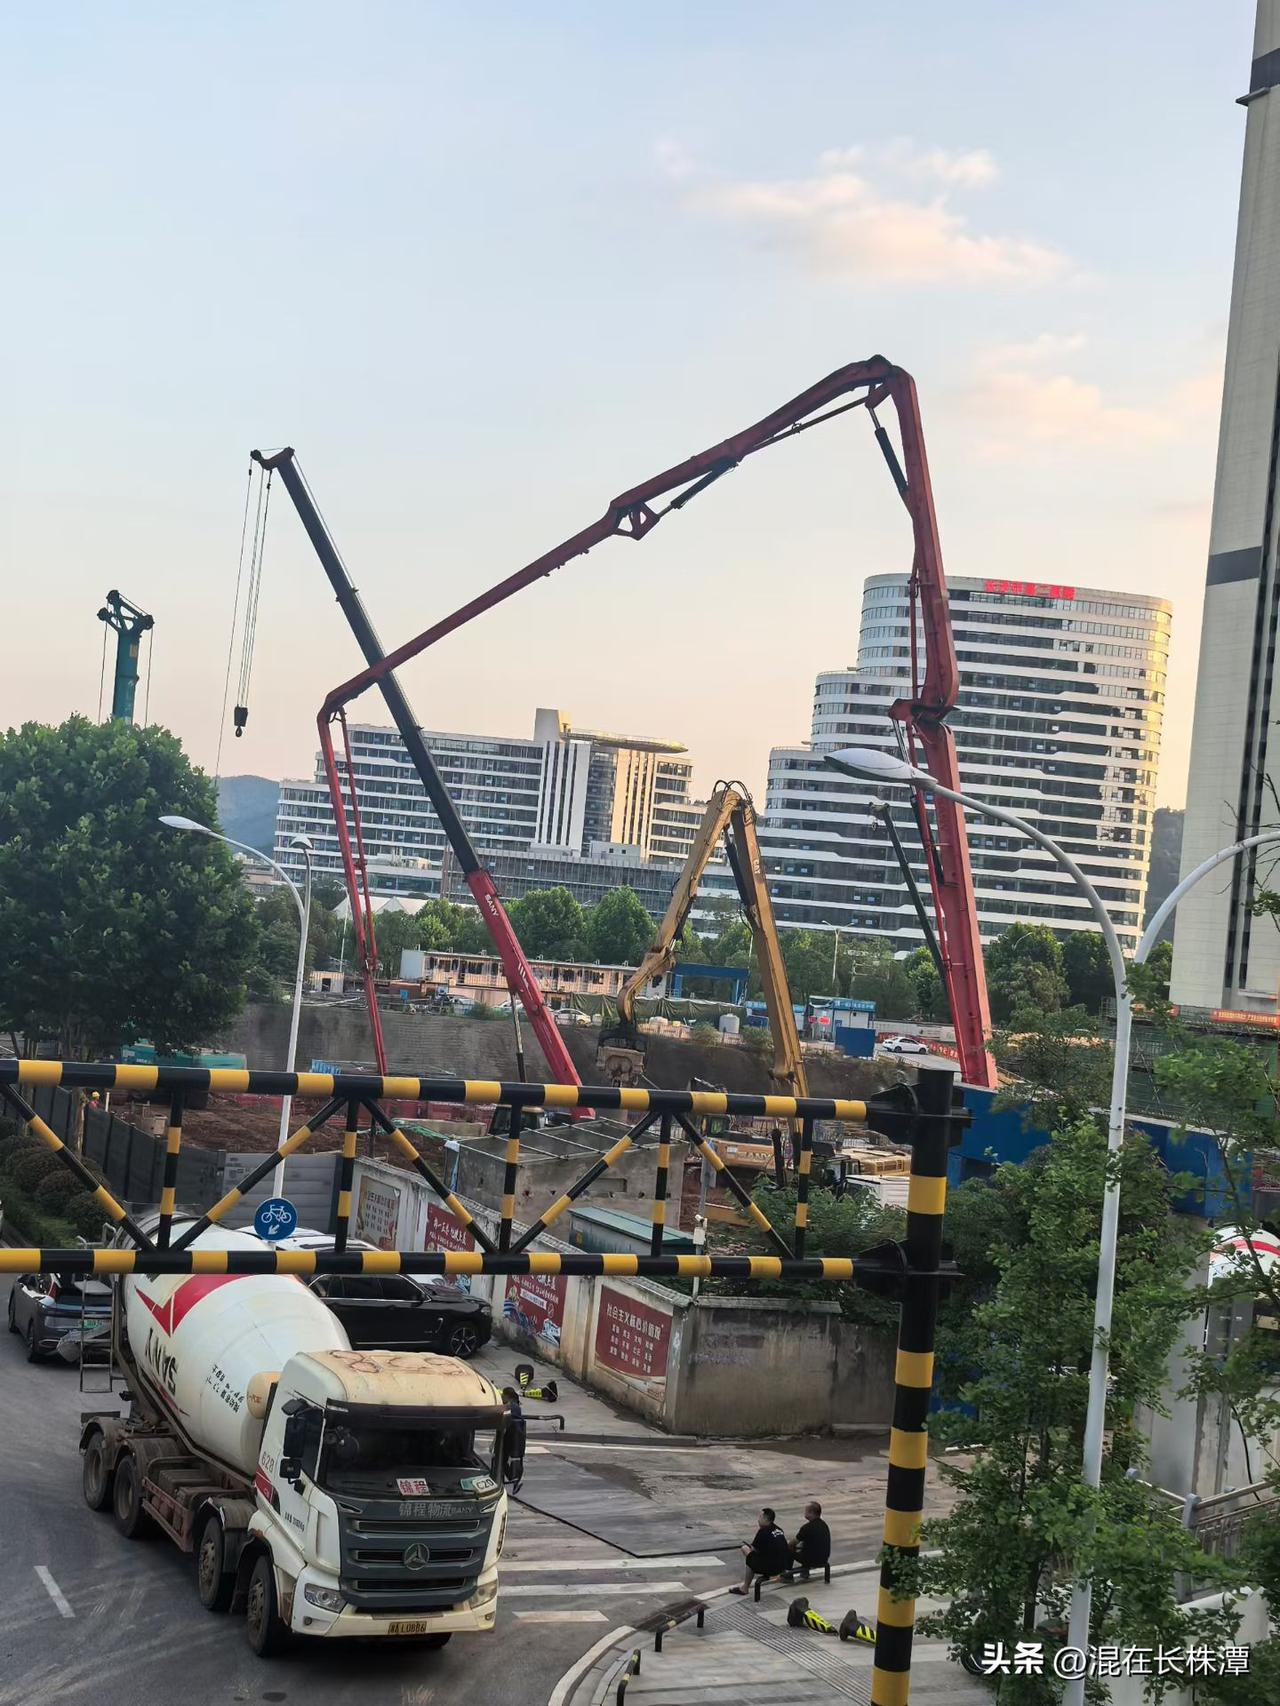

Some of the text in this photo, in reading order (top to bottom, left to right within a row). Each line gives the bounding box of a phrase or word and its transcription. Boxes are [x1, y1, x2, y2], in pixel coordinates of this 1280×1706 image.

[485, 894, 499, 916] SANY
[399, 1479, 428, 1494] 锦程
[475, 1478, 494, 1490] C20
[399, 1502, 452, 1518] 锦程物流
